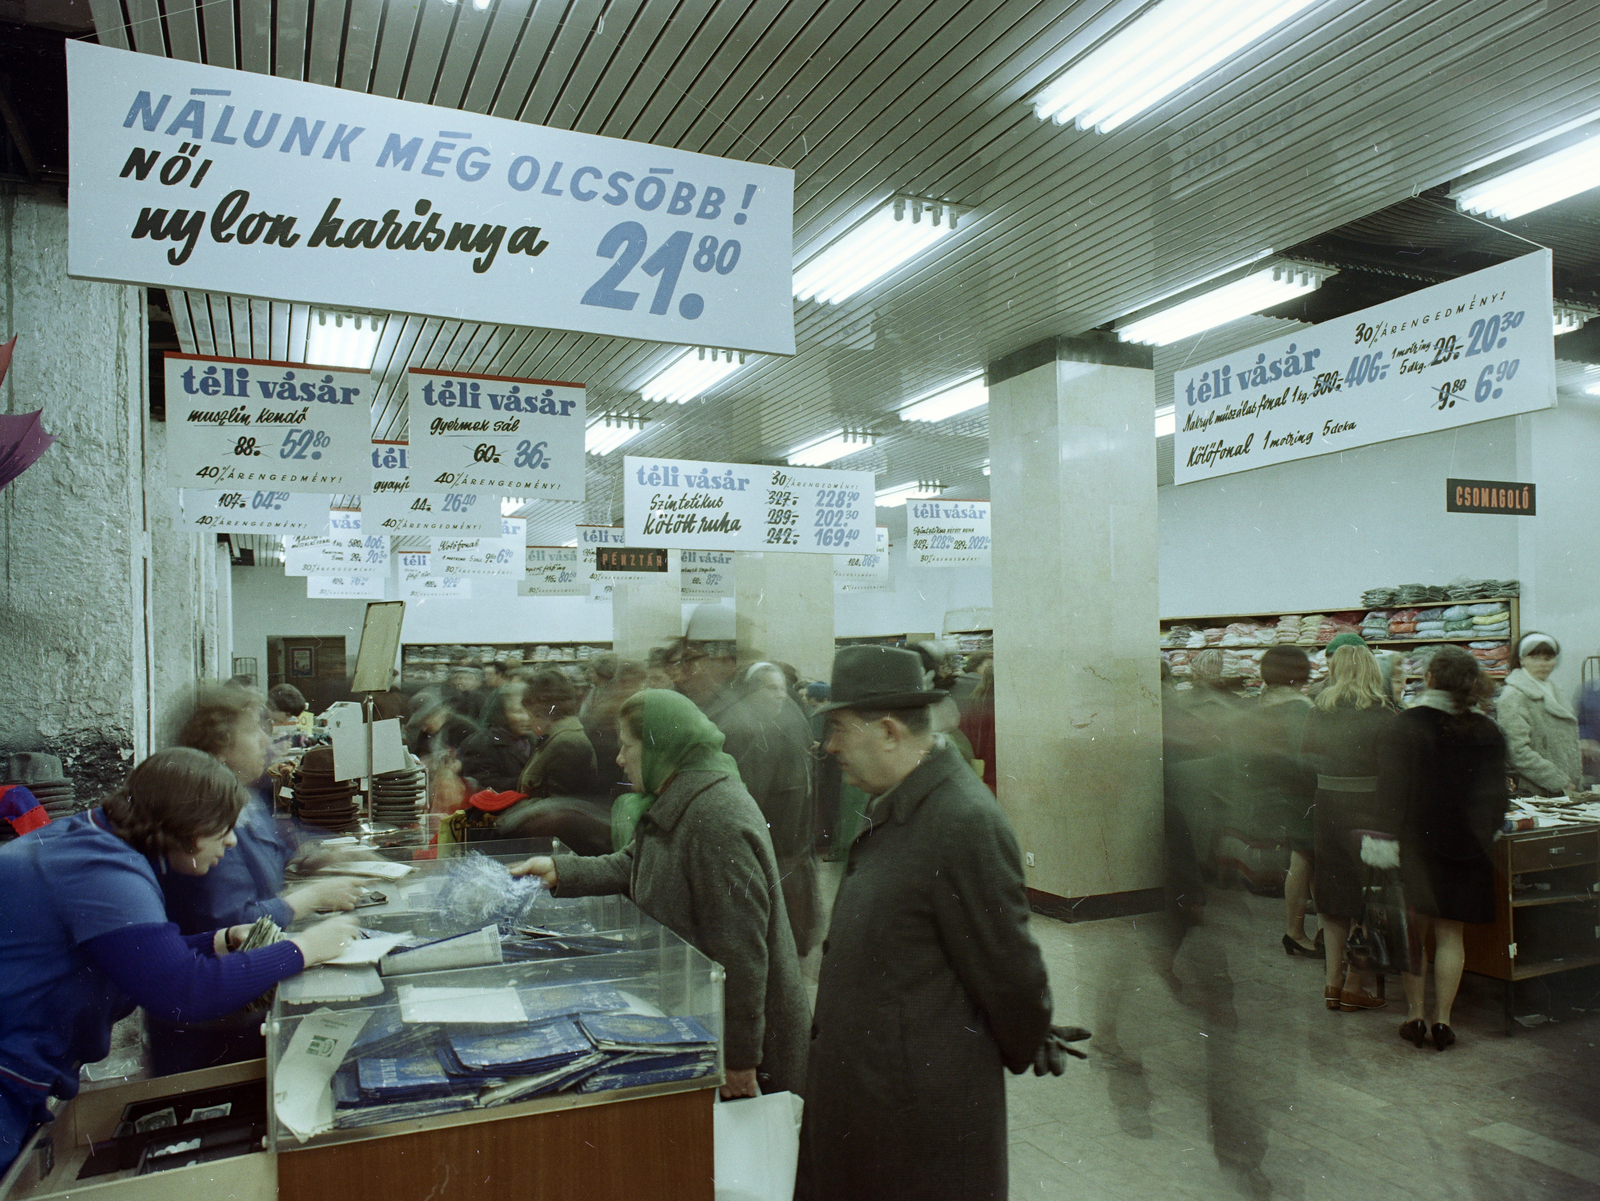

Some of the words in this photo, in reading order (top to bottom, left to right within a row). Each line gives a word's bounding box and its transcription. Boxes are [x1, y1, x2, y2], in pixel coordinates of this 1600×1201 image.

[119, 143, 213, 189] NŐI
[131, 189, 299, 266] nylon
[307, 198, 548, 274] harisnya
[1354, 321, 1384, 348] 30%
[1380, 291, 1506, 338] ÁRENGEDMÉNY!
[1185, 363, 1232, 407] téli
[1237, 343, 1321, 391] vásár
[180, 366, 250, 397] téli
[257, 371, 360, 405] vásár
[422, 380, 482, 409] téli
[487, 385, 576, 417] vásár
[1256, 386, 1291, 418] fonal
[187, 405, 251, 426] muszlin
[430, 417, 489, 435] gyermek
[493, 416, 521, 432] sál
[371, 447, 409, 469] tél
[1186, 433, 1255, 468] Kötőfonal
[195, 465, 231, 484] 40%
[227, 468, 343, 484] ÁRENGEDMÉNY!
[434, 472, 464, 489] 40%
[461, 476, 561, 490] ÁRENGEDMÉNY!
[636, 465, 679, 488] téli
[683, 467, 750, 491] vásár
[771, 470, 793, 489] 30%
[791, 480, 859, 490] ÁRENGEDMÉNY!
[650, 493, 724, 511] Szintetikus
[1455, 485, 1529, 510] CSOMAGOLÓ
[913, 503, 941, 519] téli
[943, 503, 987, 520] vásár
[195, 515, 222, 529] 40%
[219, 517, 308, 529] ÁRENGEDMÉNY!
[331, 514, 361, 530] vás
[381, 518, 404, 531] 40%
[402, 520, 482, 530] ÁRENGEDMÉNY!
[643, 512, 697, 535] kötött
[697, 512, 742, 534] ruha
[583, 529, 609, 543] téli
[403, 554, 427, 566] téli
[527, 550, 545, 561] éli
[548, 549, 577, 561] vásá
[602, 551, 663, 567] PÉNZTÁR
[681, 551, 697, 563] éli
[699, 552, 732, 564] vásár
